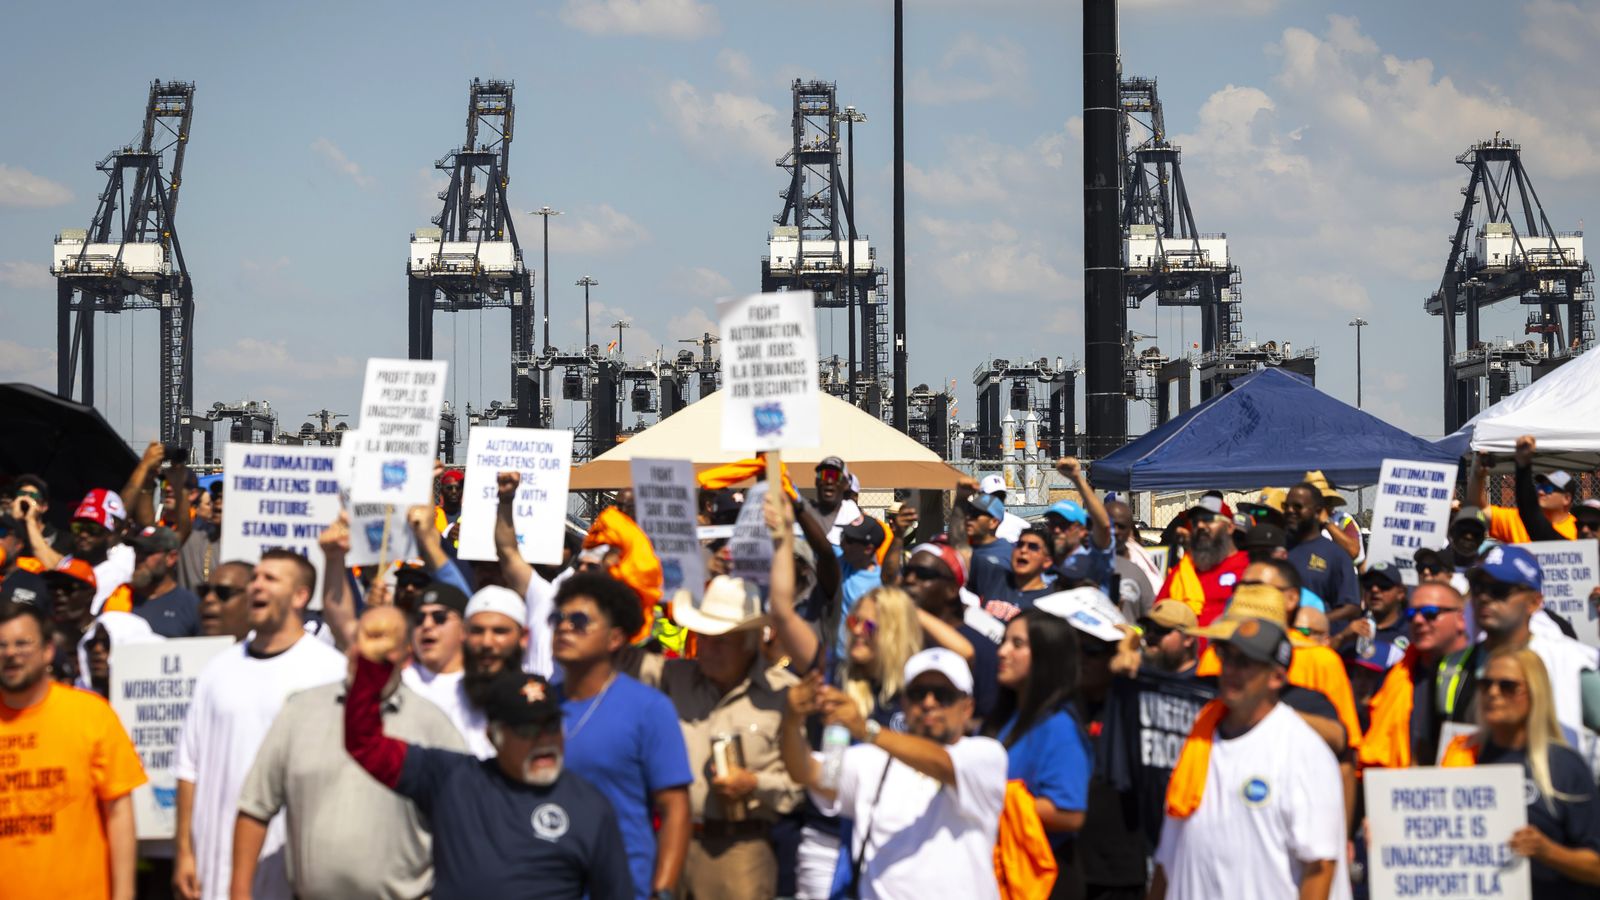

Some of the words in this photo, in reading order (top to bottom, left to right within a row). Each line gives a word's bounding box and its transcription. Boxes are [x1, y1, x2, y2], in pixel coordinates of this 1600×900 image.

[737, 345, 762, 360] SAVE
[731, 362, 747, 378] ILA
[752, 360, 806, 378] DEMANDS
[377, 371, 411, 384] PROFIT
[413, 373, 436, 385] OVER
[381, 388, 417, 401] PEOPLE
[731, 382, 750, 397] JOB
[753, 379, 808, 397] SECURITY
[379, 422, 422, 437] SUPPORT
[384, 440, 429, 454] WORKERS
[485, 440, 553, 453] AUTOMATION
[243, 453, 334, 472] AUTOMATION
[476, 454, 535, 470] THREATENS
[538, 458, 561, 470] OUR
[1391, 467, 1446, 482] AUTOMATION
[234, 476, 310, 494] THREATENS
[1382, 483, 1429, 498] THREATENS
[1430, 487, 1448, 500] OUR
[521, 489, 547, 502] WITH
[258, 499, 314, 517] FUTURE:
[242, 521, 287, 537] STAND
[1383, 516, 1411, 530] STAND
[1413, 520, 1436, 533] WITH
[1391, 534, 1405, 547] THE
[1571, 567, 1591, 580] OUR
[1560, 599, 1584, 612] WITH
[162, 655, 181, 674] ILA
[123, 678, 182, 699] WORKERS
[1391, 787, 1447, 811] PROFIT
[1452, 785, 1497, 811] OVER
[1404, 815, 1464, 839] PEOPLE
[1469, 815, 1487, 839] IS
[1395, 871, 1468, 896] SUPPORT
[1474, 872, 1502, 895] ILA
